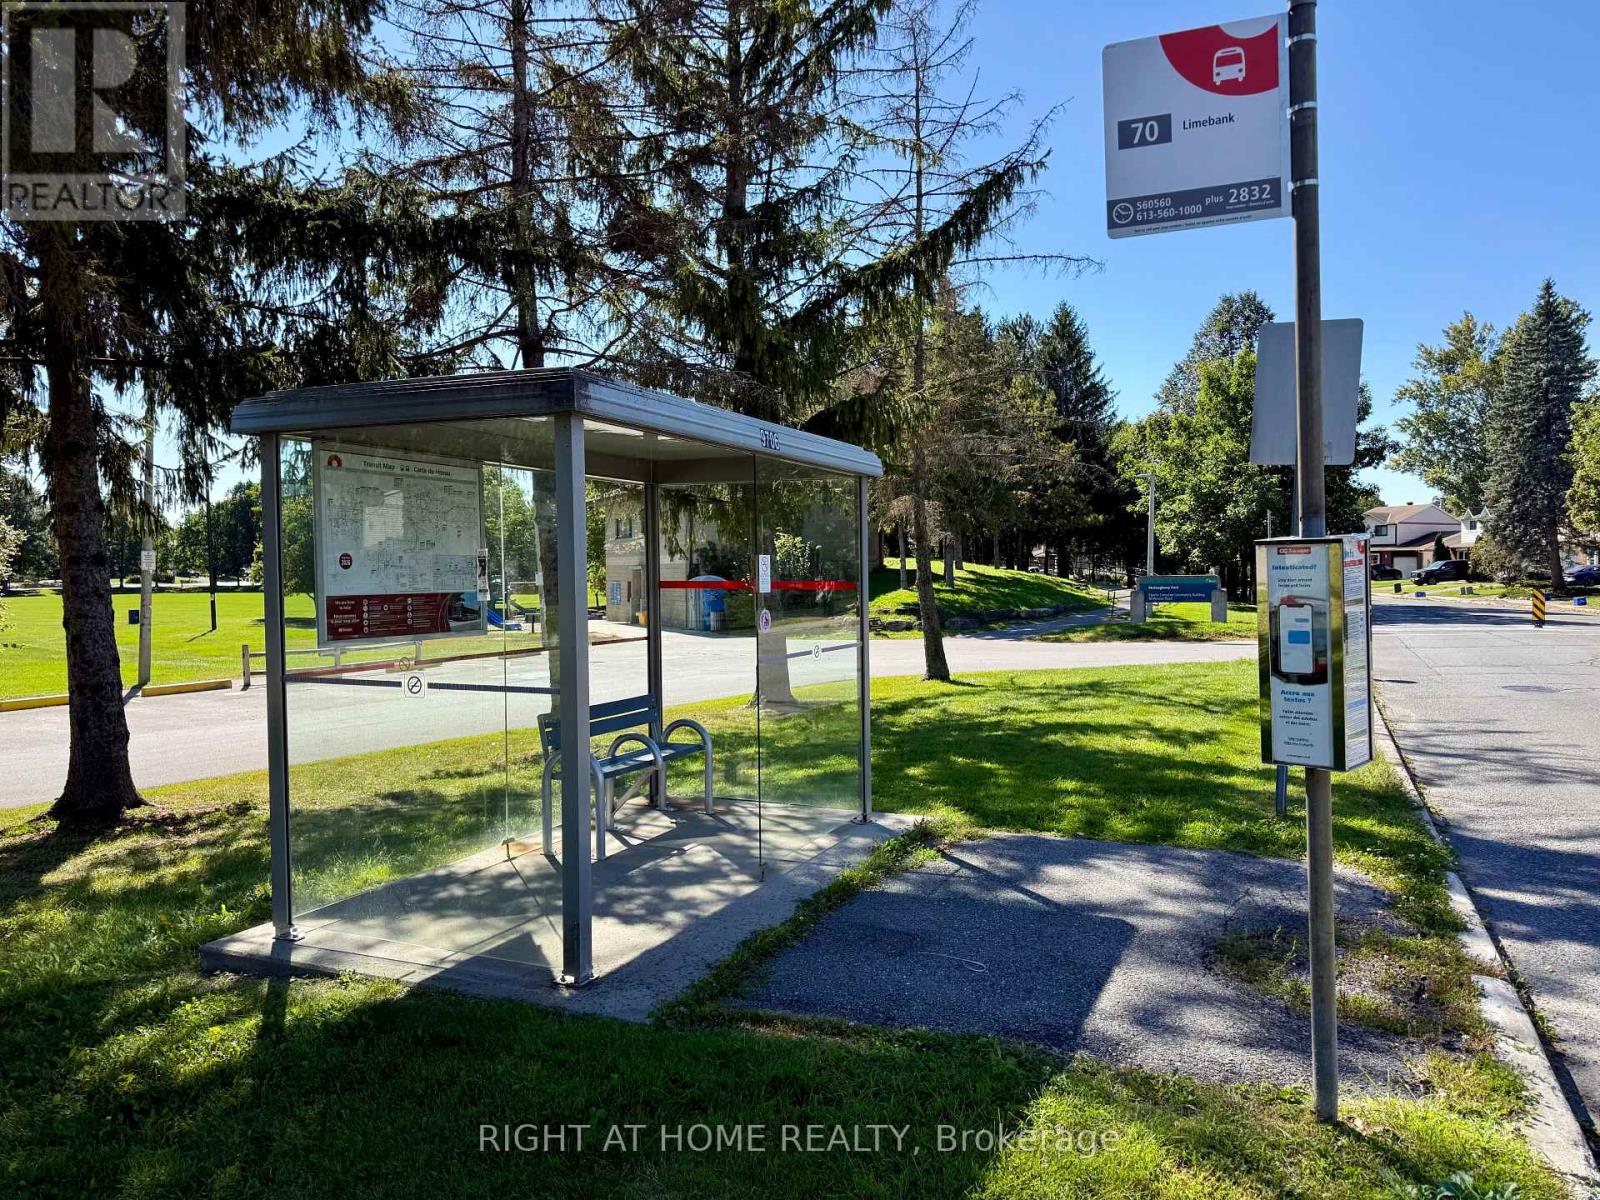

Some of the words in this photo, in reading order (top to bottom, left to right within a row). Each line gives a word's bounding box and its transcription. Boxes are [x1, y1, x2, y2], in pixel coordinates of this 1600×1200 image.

[1131, 121, 1159, 144] 70
[1182, 113, 1236, 131] Limebank
[1136, 197, 1172, 211] 560560
[1205, 195, 1225, 206] plus
[1229, 184, 1272, 204] 2832
[1136, 204, 1203, 222] 613-560-1000
